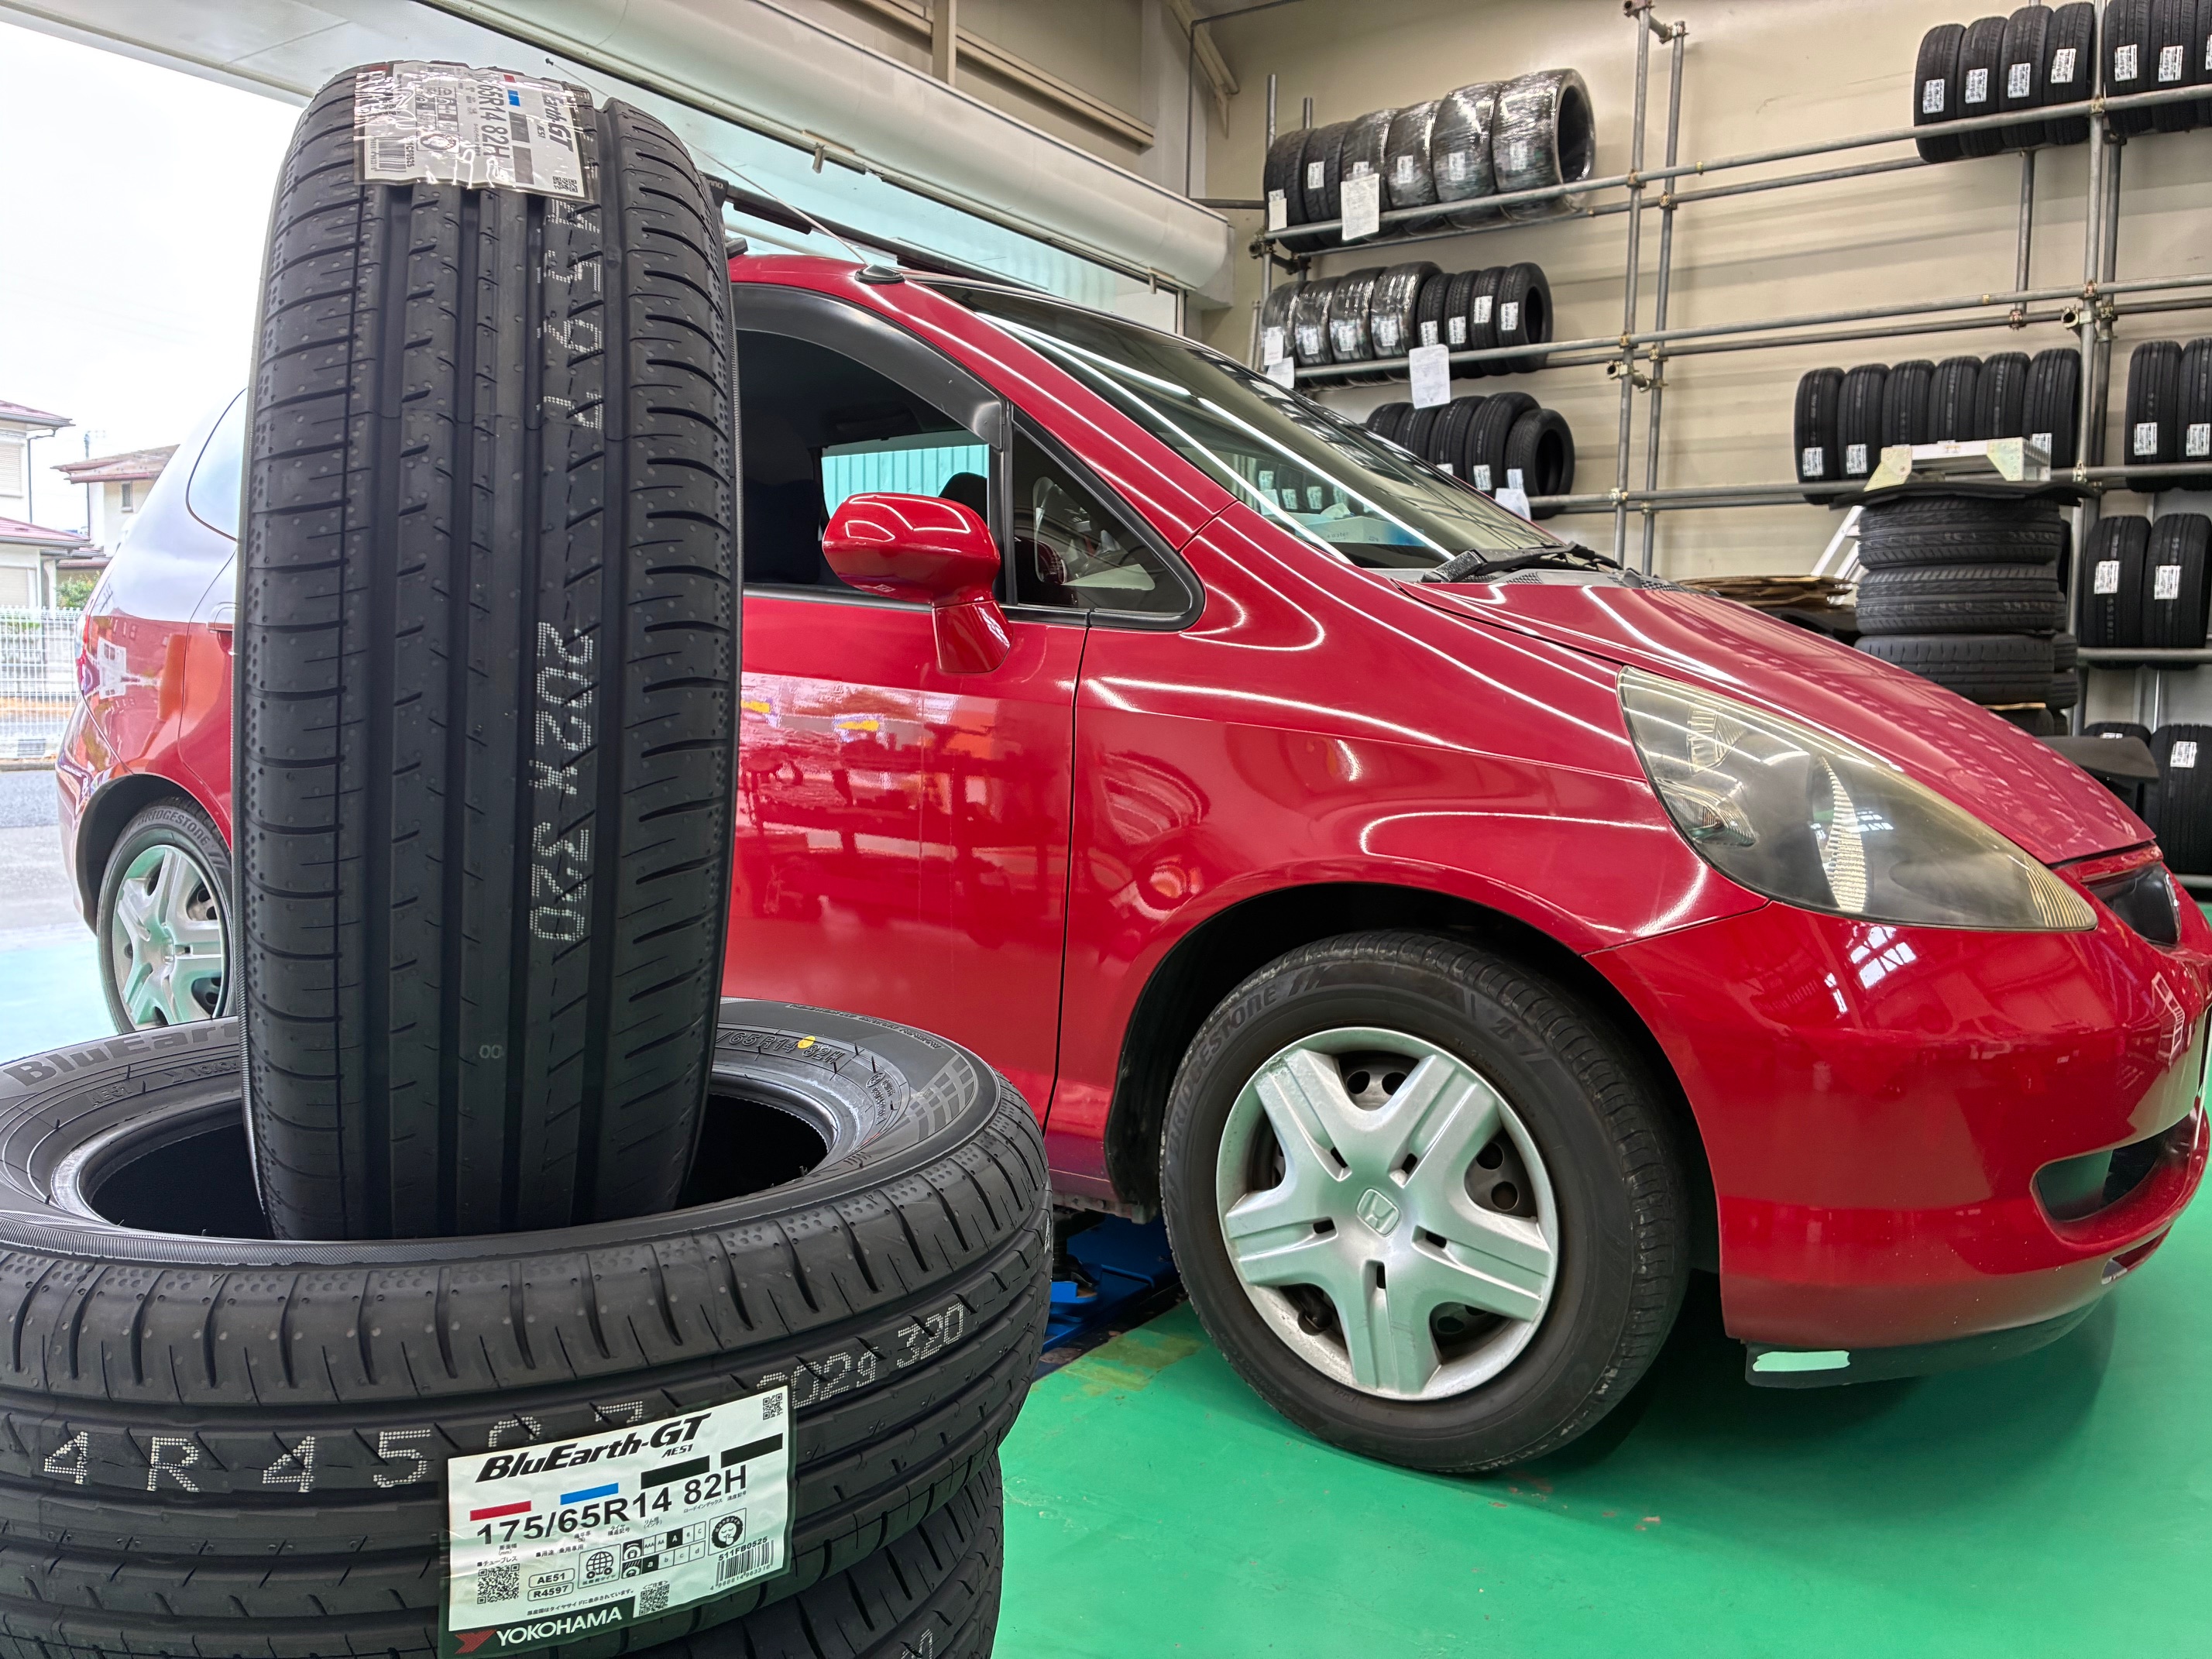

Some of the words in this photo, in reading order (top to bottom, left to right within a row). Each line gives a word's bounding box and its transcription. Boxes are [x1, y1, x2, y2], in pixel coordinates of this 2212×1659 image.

[541, 87, 575, 153] Earth-GT
[481, 124, 510, 159] 82H
[136, 809, 210, 846] BRIDGESTONE
[715, 1030, 799, 1053] /65R14
[802, 1042, 844, 1065] 82H
[1169, 985, 1277, 1159] BRIDGESTONE
[896, 1301, 964, 1369] 320
[475, 1412, 713, 1483] BluEarth-GT
[661, 1444, 694, 1458] AE51
[476, 1486, 673, 1546] 175/65R14
[683, 1464, 747, 1505] 82H
[672, 1534, 678, 1543] A
[718, 1536, 768, 1561] 511FB0525
[533, 1585, 568, 1599] R4597
[537, 1571, 565, 1585] AE51
[496, 1606, 623, 1647] YOKOHAMA
